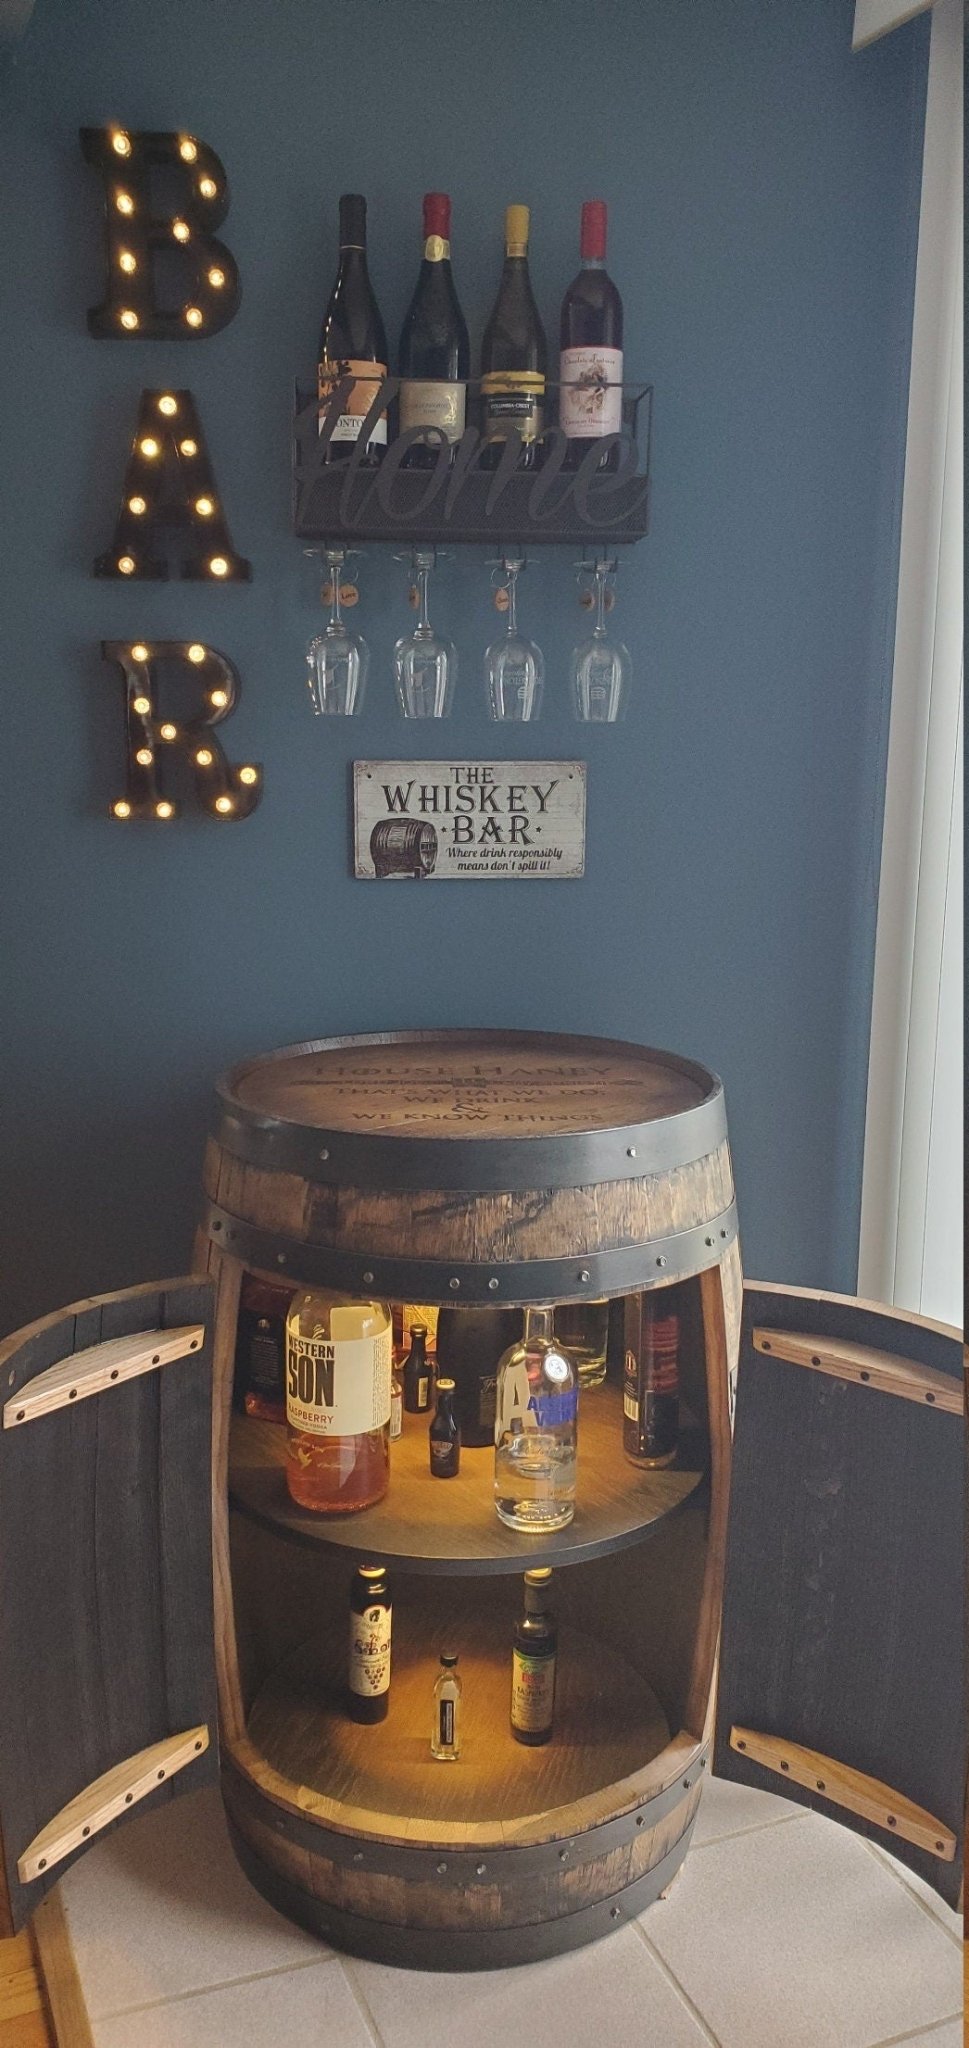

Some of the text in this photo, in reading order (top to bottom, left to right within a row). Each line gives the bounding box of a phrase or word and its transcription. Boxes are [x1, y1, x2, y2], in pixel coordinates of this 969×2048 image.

[294, 376, 650, 528] Home
[450, 766, 495, 785] THE
[381, 779, 560, 814] WHISKEY
[451, 815, 536, 846] BAR
[446, 847, 563, 860] Where drink responsibly
[457, 860, 551, 873] means don't spill it!
[316, 1065, 611, 1076] HOUSE HANEY
[404, 1096, 443, 1104] WE
[426, 1088, 499, 1096] WHAT
[451, 1102, 490, 1113] &
[288, 1334, 336, 1359] WESTERN
[288, 1402, 334, 1425] RASPBERRY
